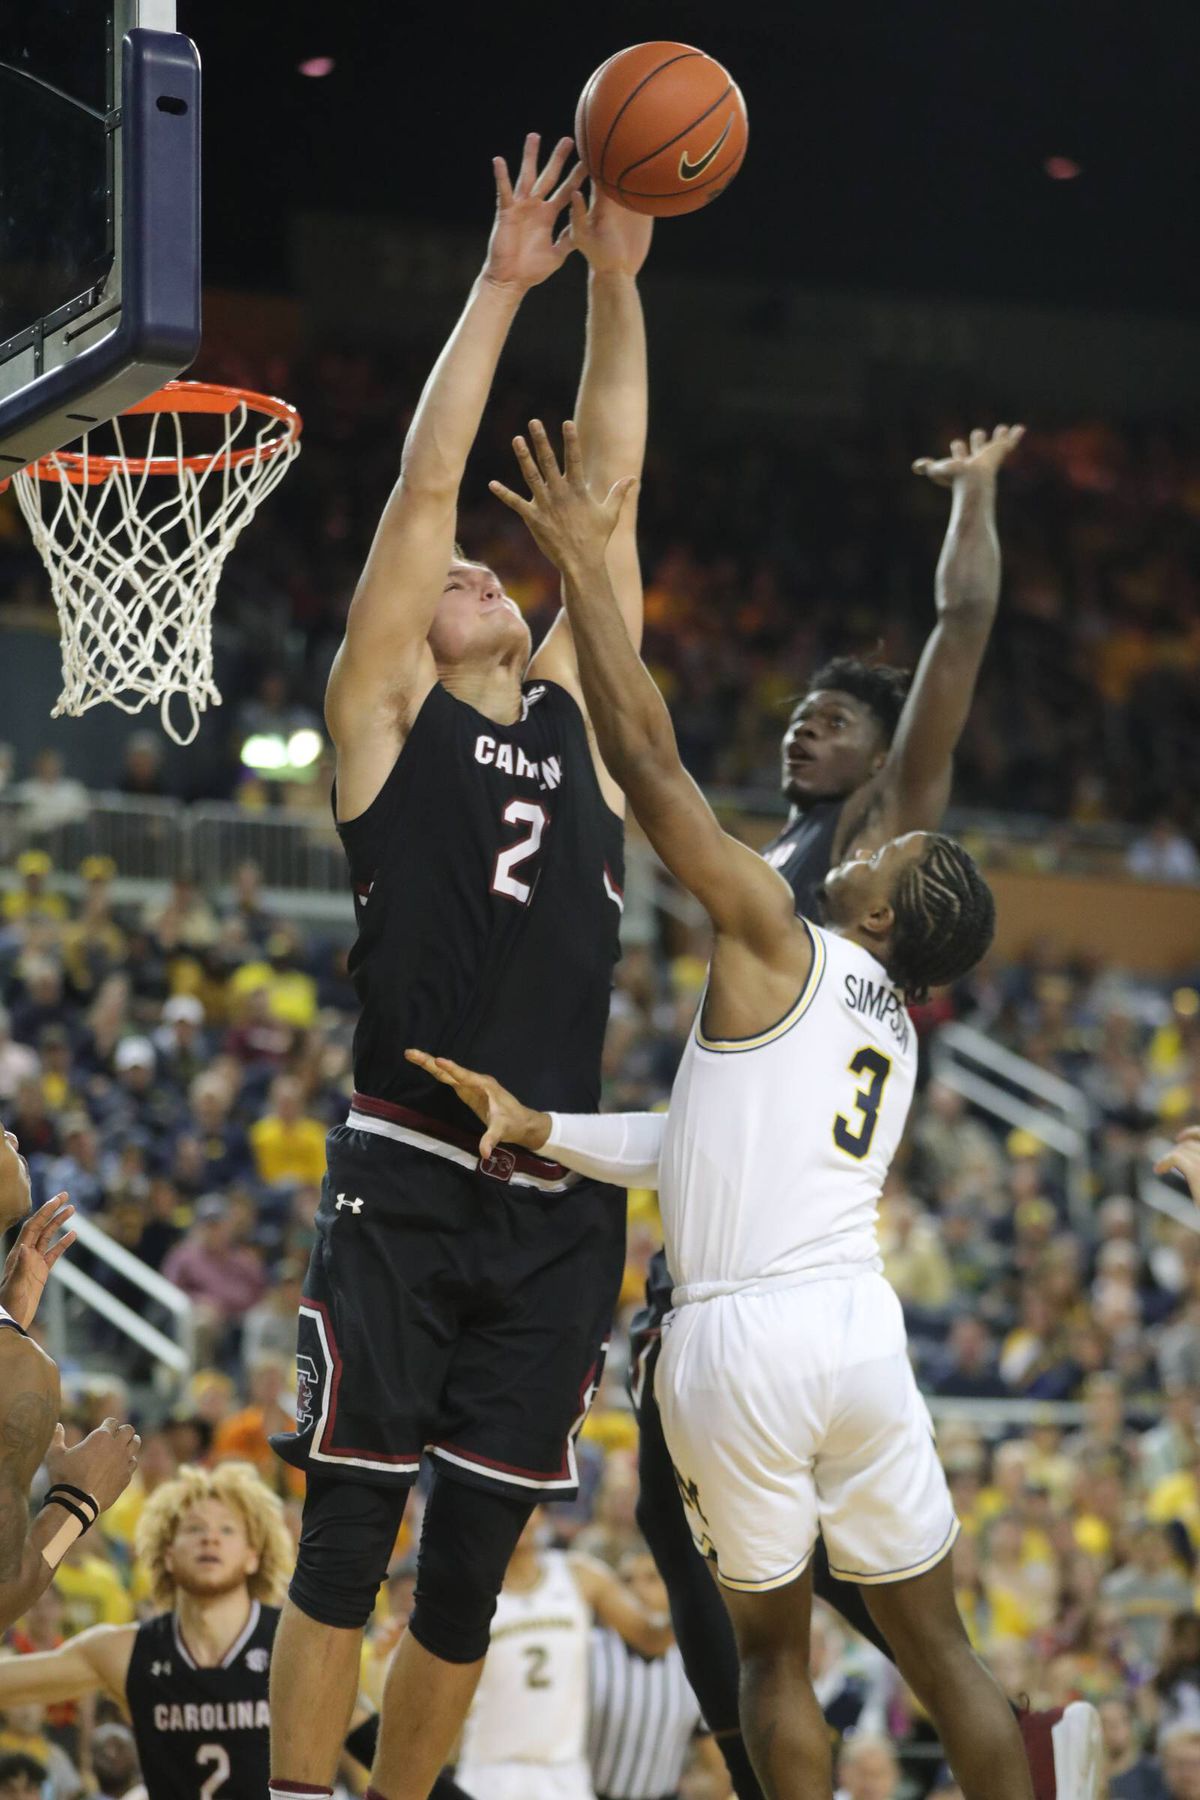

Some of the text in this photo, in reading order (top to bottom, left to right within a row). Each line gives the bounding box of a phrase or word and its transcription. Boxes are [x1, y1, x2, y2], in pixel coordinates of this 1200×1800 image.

[491, 798, 547, 905] 2
[832, 1045, 891, 1161] 3
[523, 1645, 552, 1691] 2
[153, 1700, 271, 1731] CAROLINA
